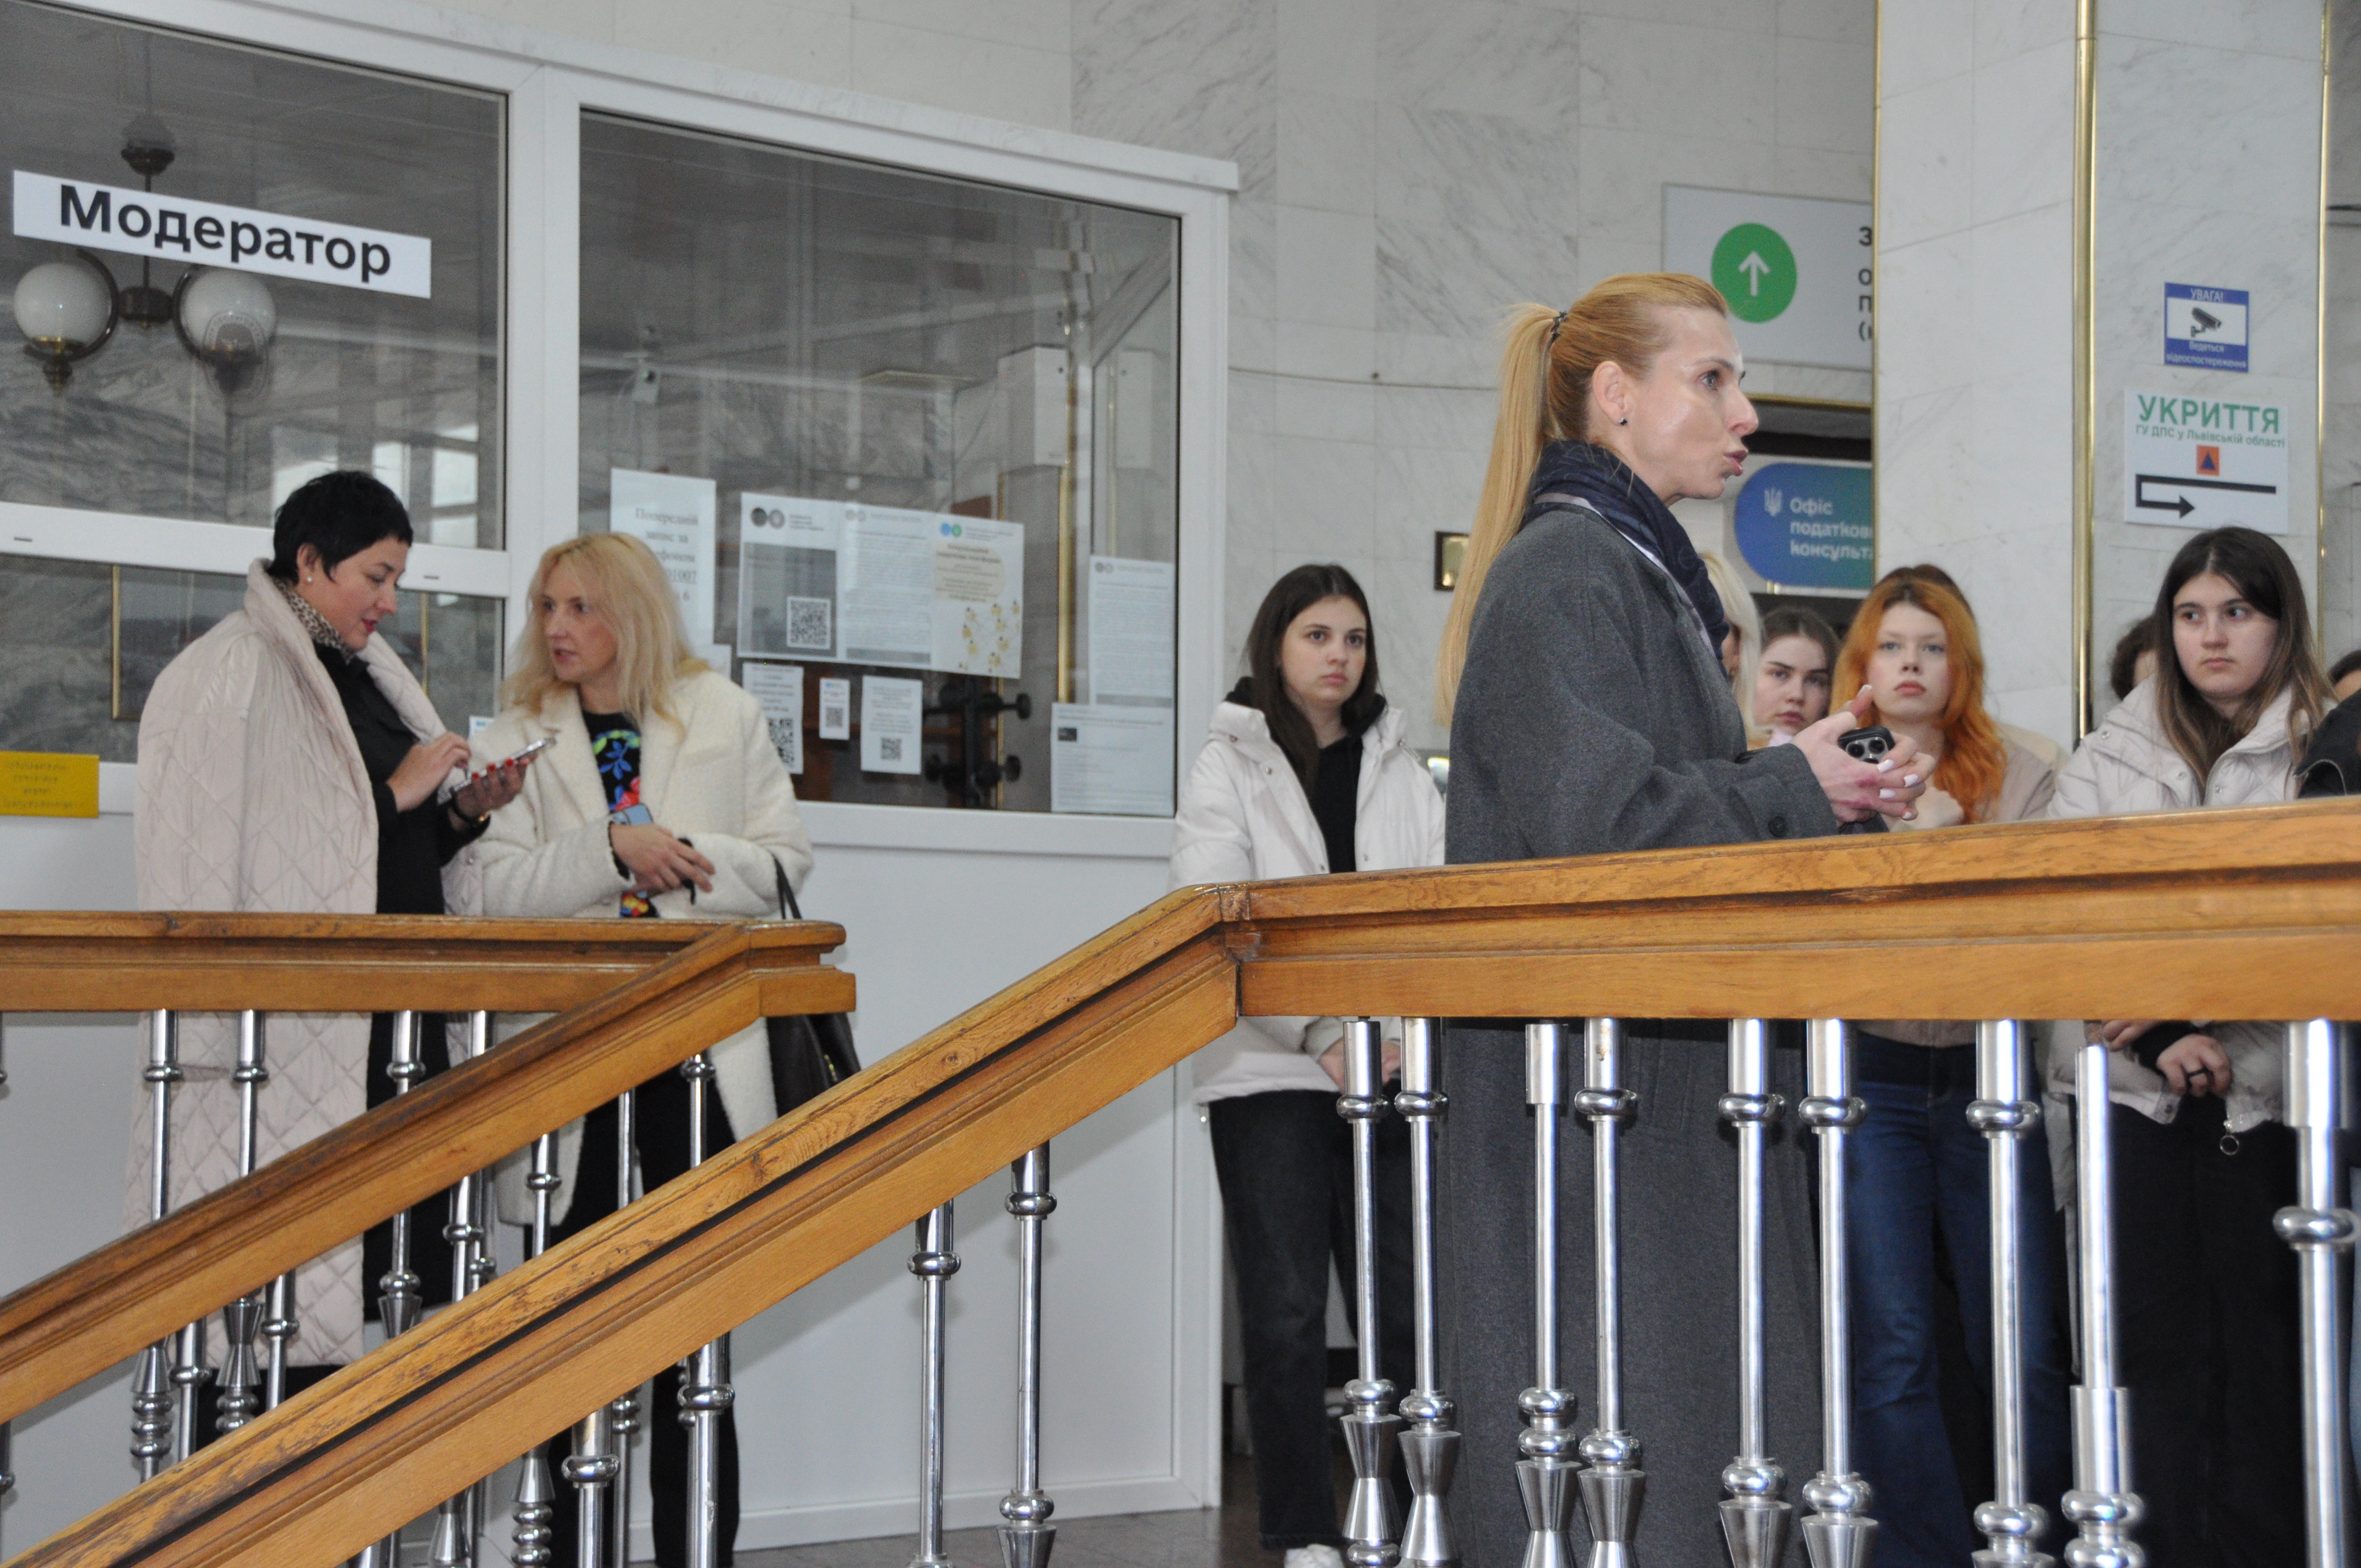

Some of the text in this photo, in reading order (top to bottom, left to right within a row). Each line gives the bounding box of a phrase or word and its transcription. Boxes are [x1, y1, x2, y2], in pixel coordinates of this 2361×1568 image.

[61, 184, 390, 283] Модератор
[2191, 288, 2223, 302] УВАГА!
[2137, 394, 2280, 434] УКРИТТЯ
[2136, 424, 2285, 448] ГУ ДПС у Львівській області
[1790, 496, 1833, 517] Офіс
